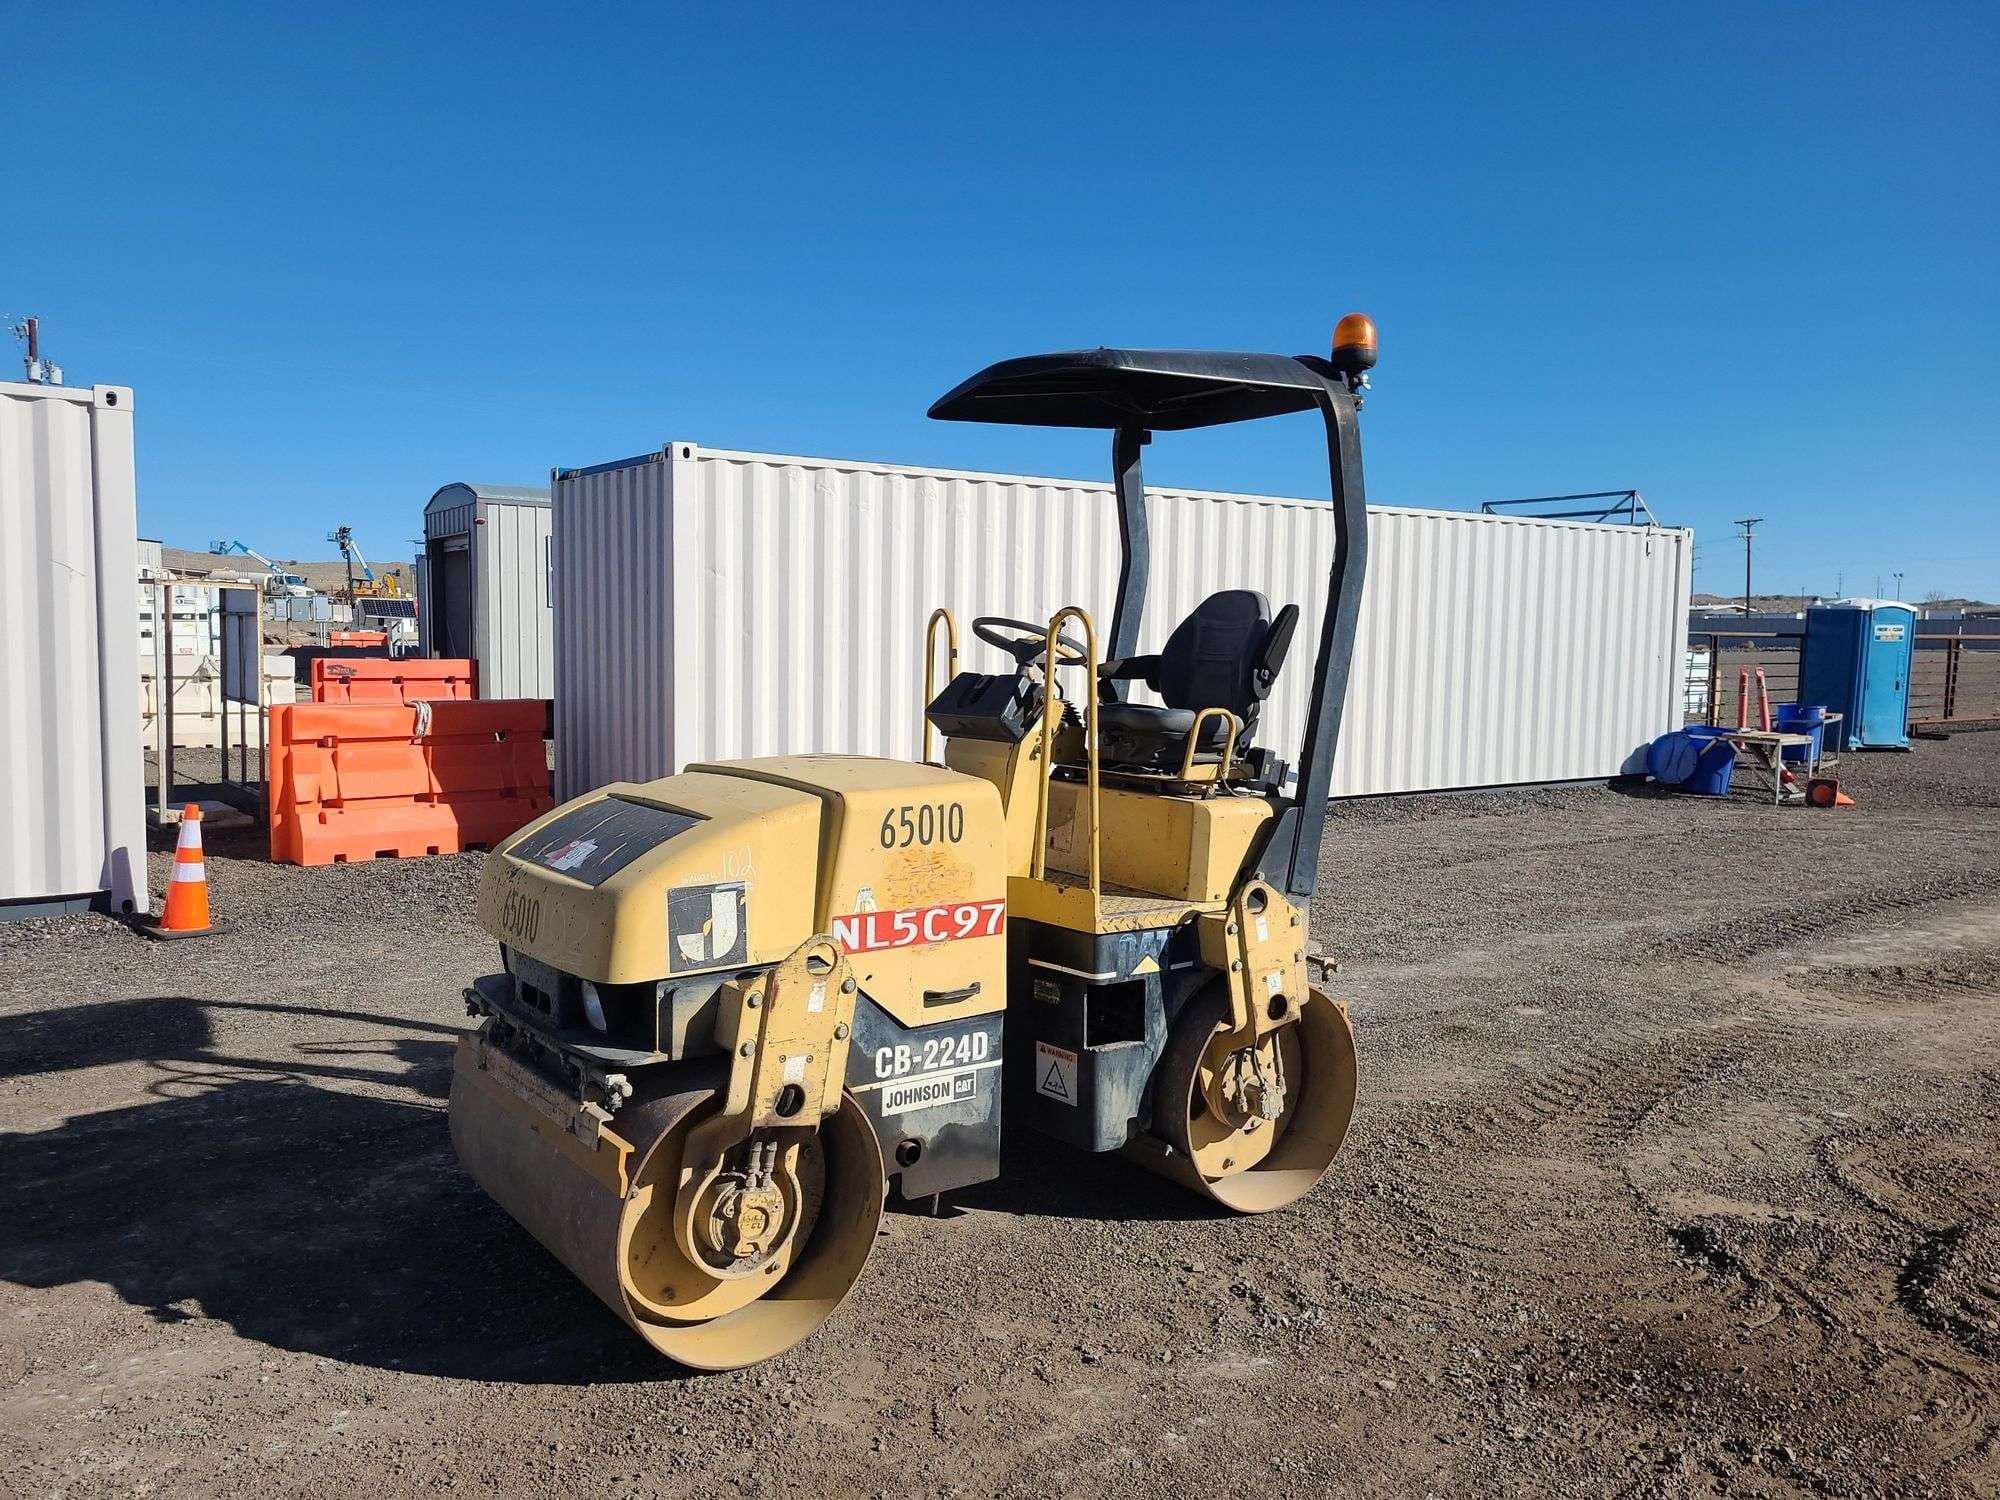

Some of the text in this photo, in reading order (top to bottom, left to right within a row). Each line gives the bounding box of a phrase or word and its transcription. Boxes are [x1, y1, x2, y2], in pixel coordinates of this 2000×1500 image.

[880, 802, 964, 849] 65010
[502, 887, 540, 944] 65010
[833, 902, 1006, 950] NL5C97
[875, 1031, 989, 1079] CB-224D
[886, 1077, 975, 1109] JOHNSON CAT
